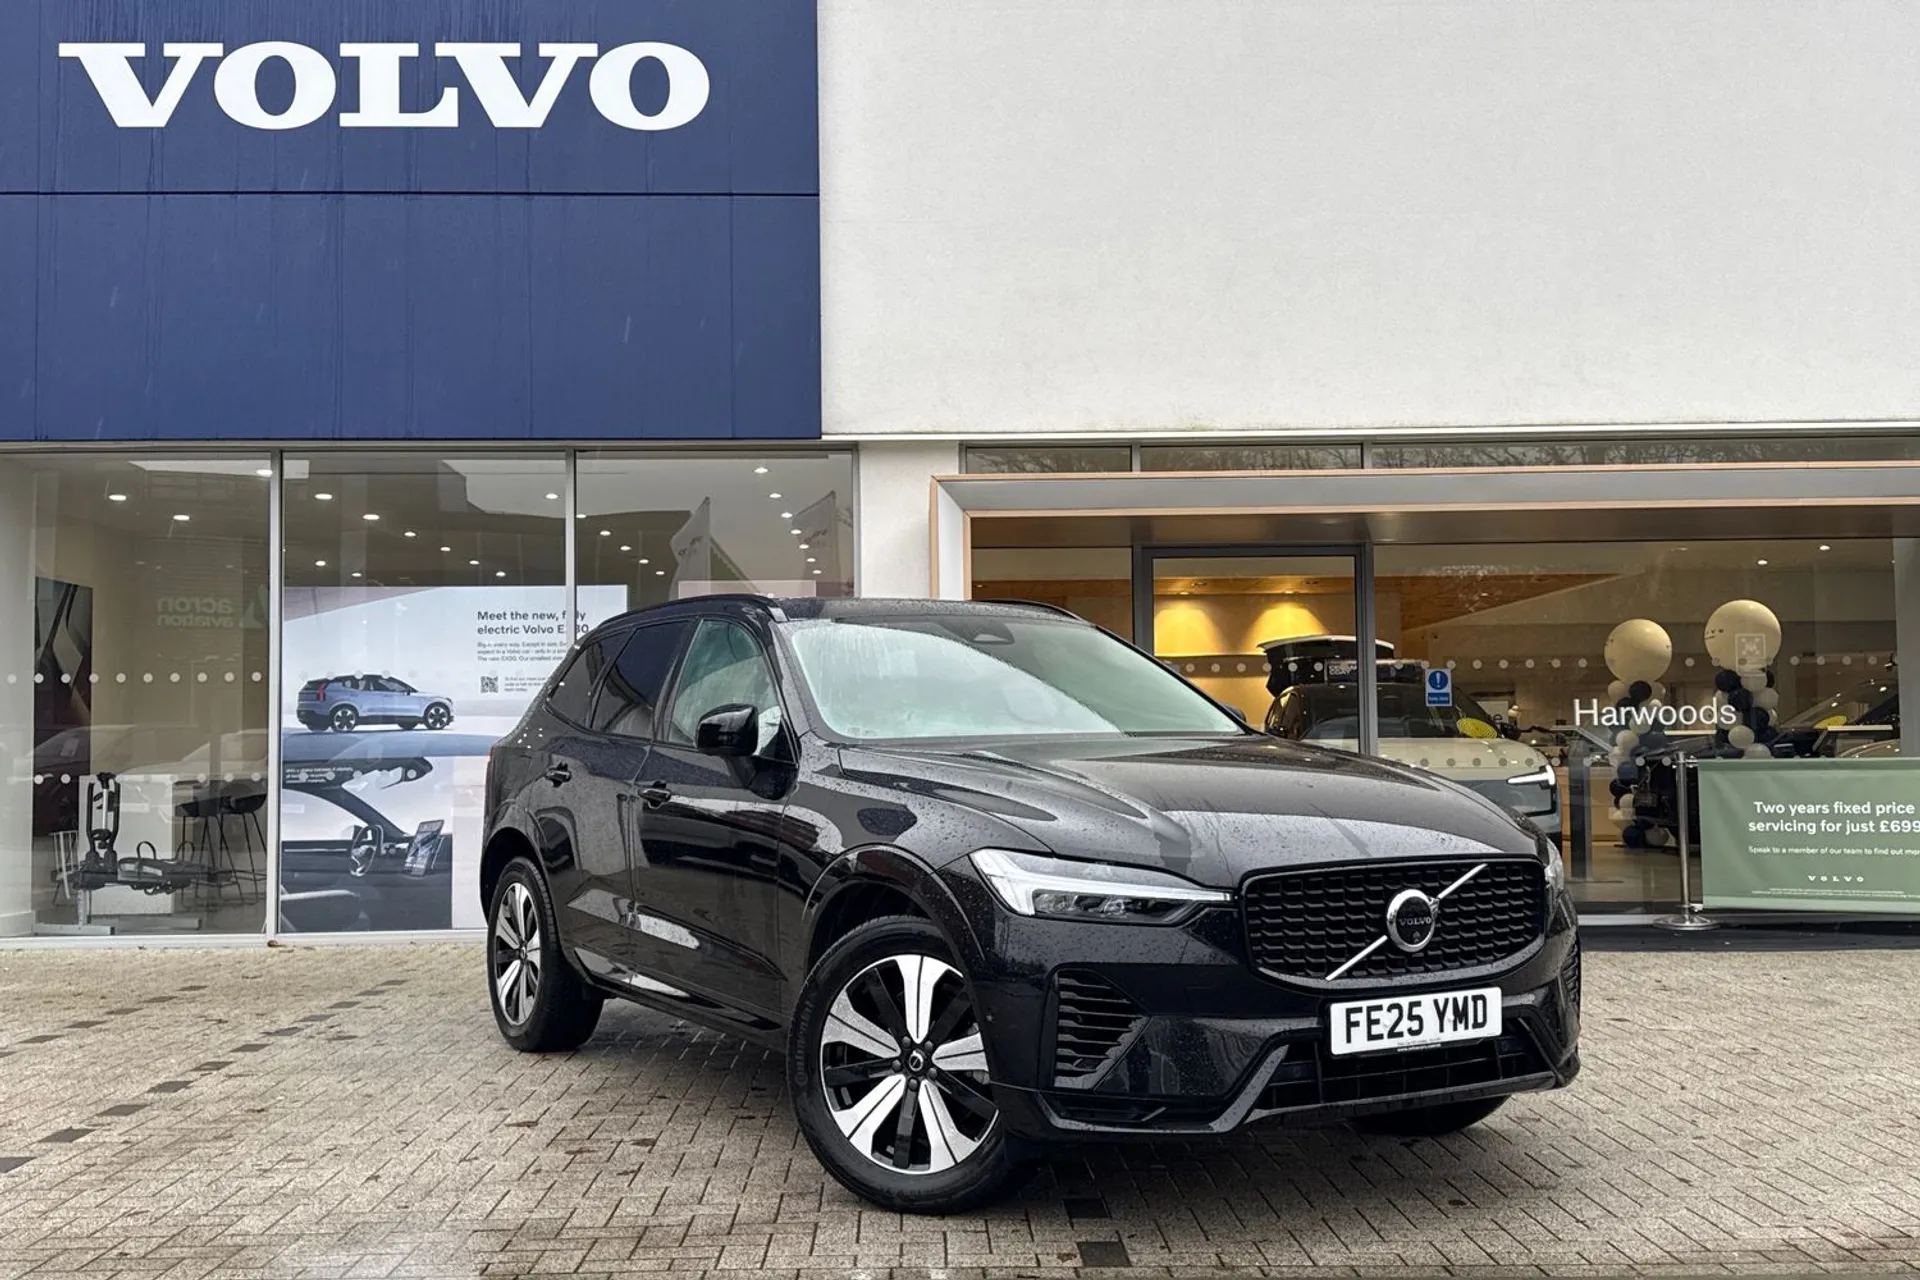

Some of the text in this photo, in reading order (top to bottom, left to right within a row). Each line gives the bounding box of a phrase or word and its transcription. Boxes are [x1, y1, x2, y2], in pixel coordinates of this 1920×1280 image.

[58, 41, 710, 131] VOLVO
[477, 610, 507, 621] Meet
[510, 610, 530, 621] the
[532, 612, 560, 622] new,
[477, 624, 520, 635] electric
[523, 624, 555, 635] Volvo
[1573, 697, 1737, 726] Harwoods
[1753, 801, 1916, 817] Two years fixed price
[1748, 819, 1920, 835] servicing for just £699
[1748, 846, 1771, 854] Speak
[1788, 846, 1819, 855] member
[1820, 846, 1829, 855] of
[1843, 847, 1863, 855] team
[1864, 847, 1873, 855] to
[1874, 847, 1889, 856] find
[1890, 848, 1904, 856] out
[1807, 875, 1865, 883] VOLVO
[1398, 916, 1432, 926] VOLVO
[1346, 993, 1488, 1045] FE25 YMD
